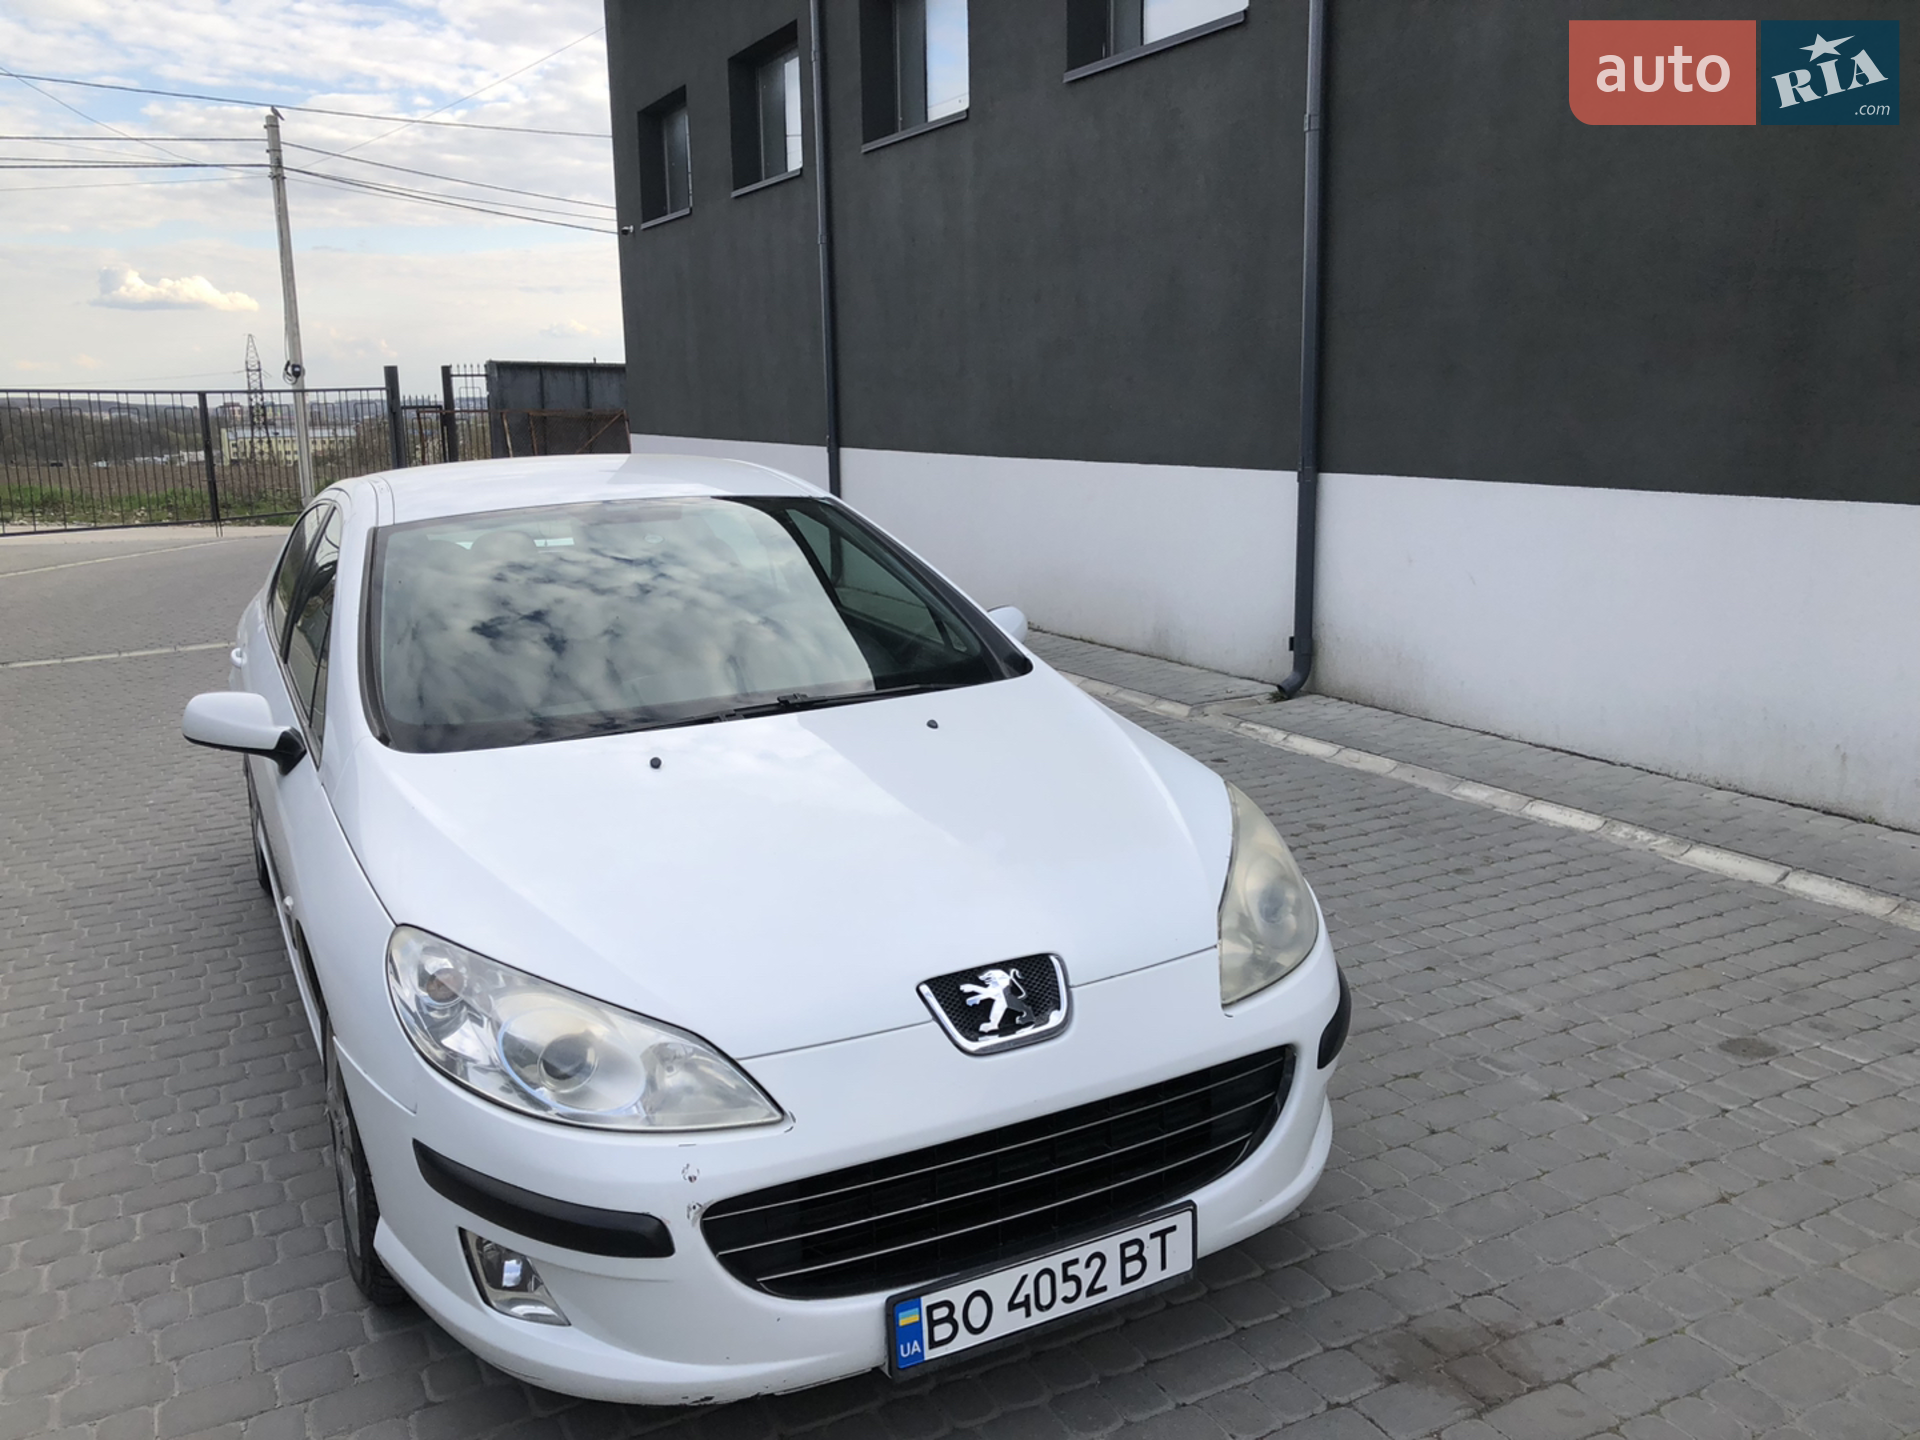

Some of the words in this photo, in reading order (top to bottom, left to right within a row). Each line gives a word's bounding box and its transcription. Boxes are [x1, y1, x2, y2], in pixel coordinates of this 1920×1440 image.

[925, 1288, 994, 1351] BO
[1007, 1251, 1108, 1319] 4052
[1118, 1224, 1178, 1287] BT
[900, 1339, 922, 1358] UA
